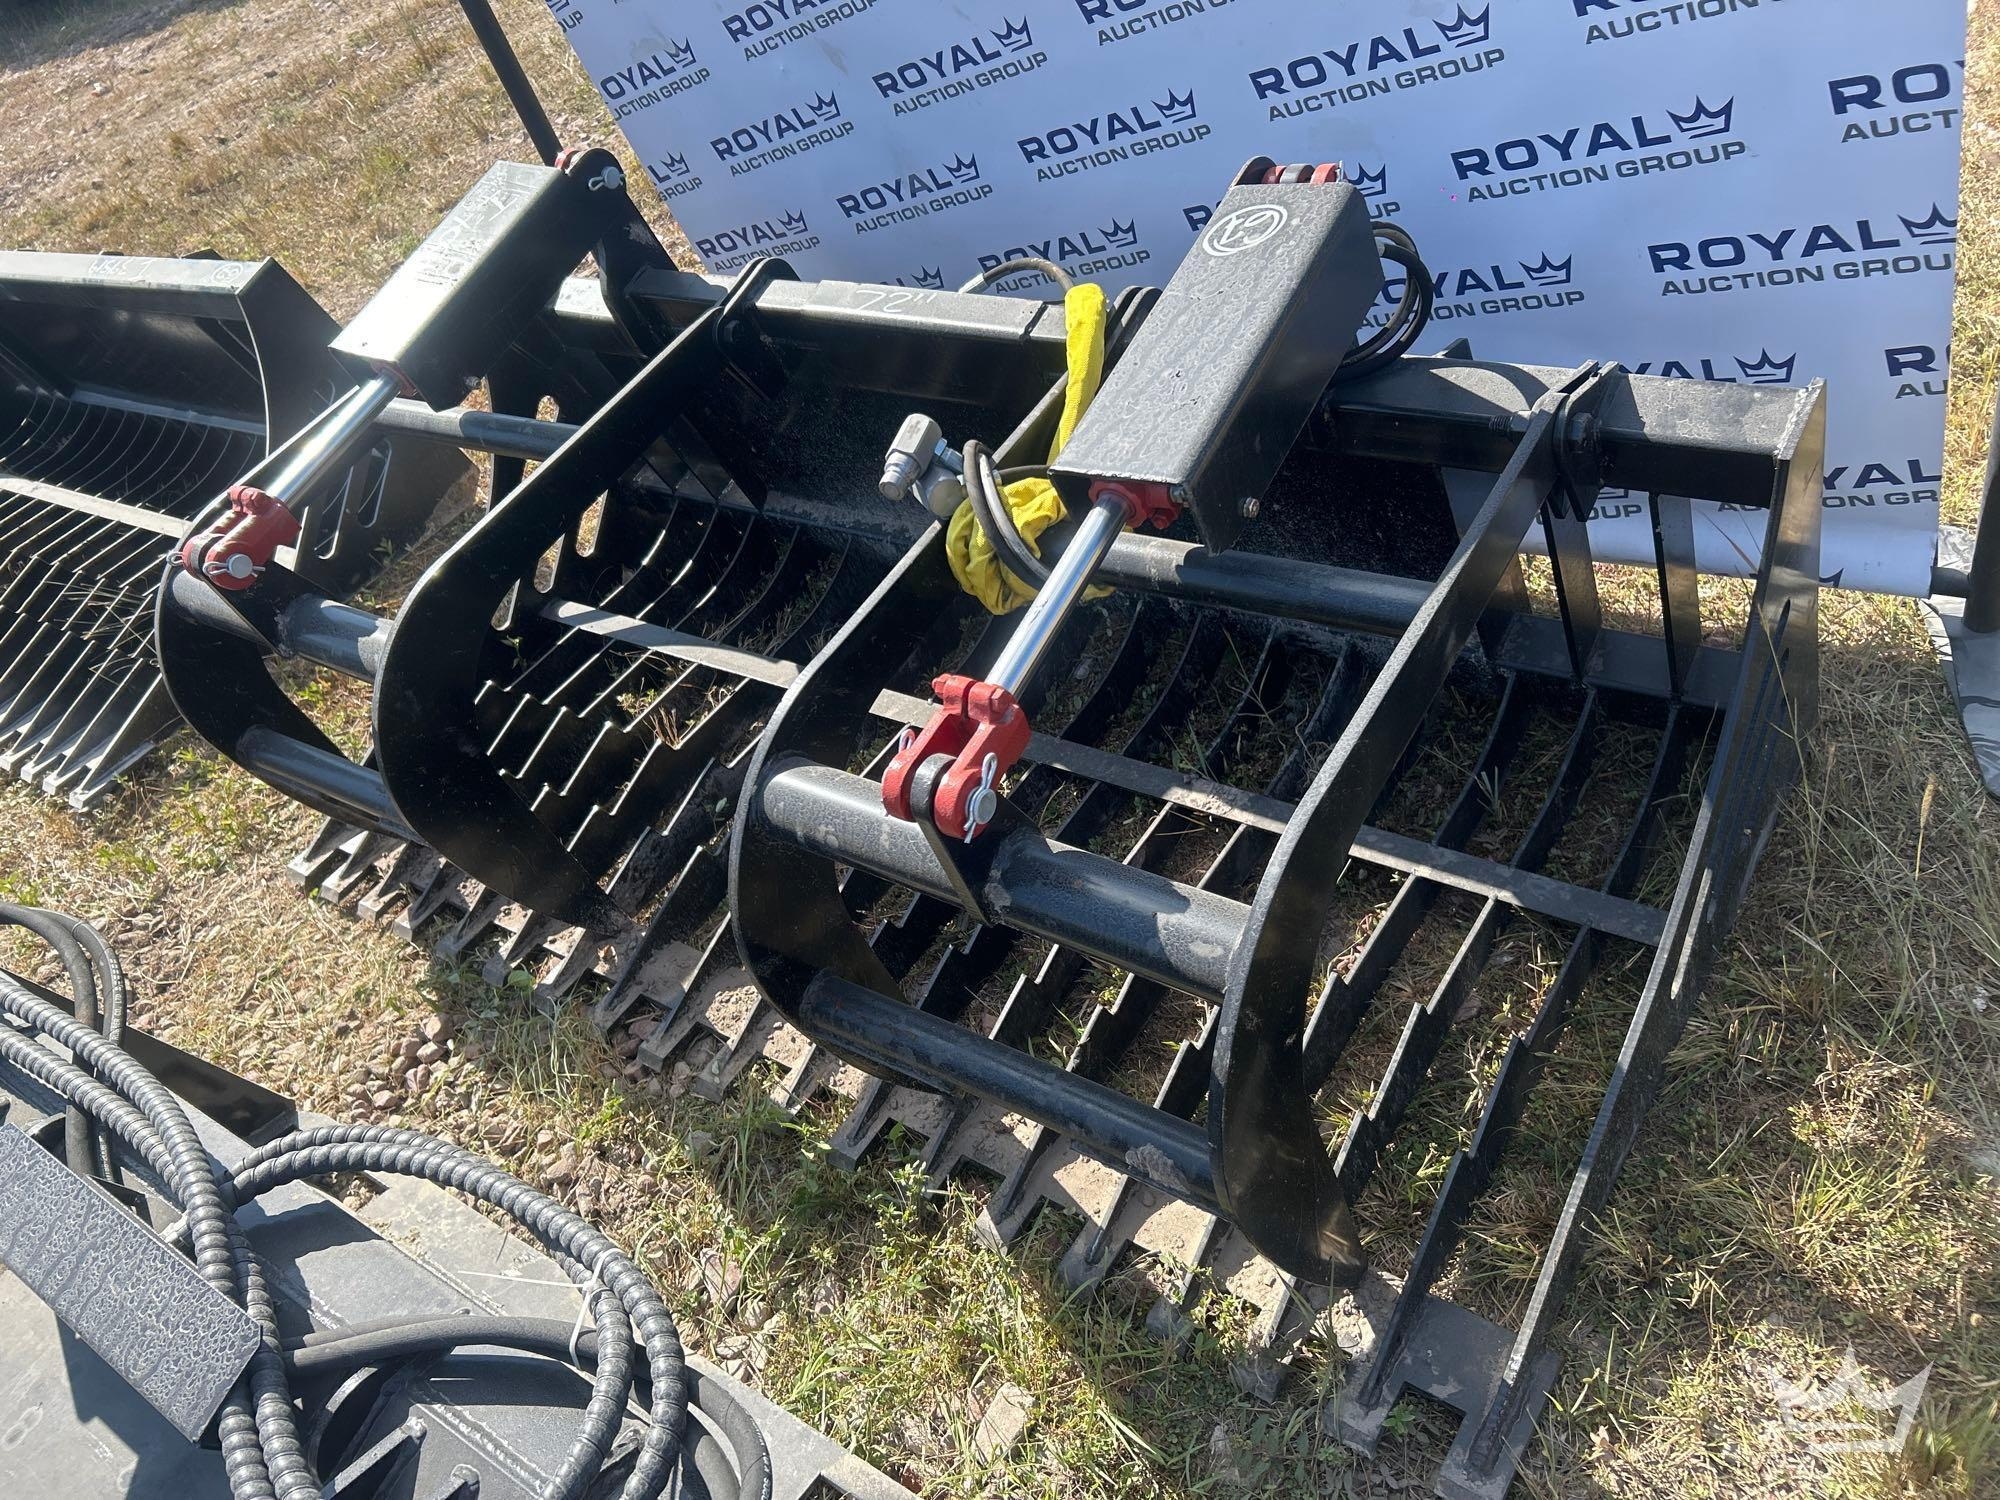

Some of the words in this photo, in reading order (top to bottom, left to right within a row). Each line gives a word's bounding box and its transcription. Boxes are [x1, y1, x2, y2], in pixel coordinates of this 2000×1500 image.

[722, 0, 831, 43] ROYA
[743, 20, 817, 62] AUCTION
[1098, 0, 1206, 46] AUCTION
[1586, 0, 1760, 44] AUCTION
[600, 54, 677, 100] OYAL
[872, 37, 1003, 98] ROYAL
[893, 78, 975, 117] AUCTION
[975, 51, 1048, 88] GROUP
[1249, 27, 1442, 100] ROYAL
[1269, 77, 1391, 122] AUCTION
[1394, 48, 1505, 90] GROUP
[614, 90, 662, 121] UCTION
[659, 68, 711, 99] GROUP
[710, 107, 817, 162] ROYAL
[729, 142, 797, 177] AUCTION
[799, 121, 855, 152] GROUP
[1017, 106, 1162, 164] ROYAL
[1450, 115, 1673, 181] ROYAL
[1841, 108, 1959, 143] AUCT
[1037, 146, 1129, 183] AUCTION
[1129, 124, 1211, 161] GROUP
[1467, 164, 1609, 203] AUCTION
[1615, 141, 1747, 178] GROUP
[835, 167, 954, 219] ROYAL
[855, 203, 930, 234] AUCTION
[929, 183, 993, 213] GROUP
[695, 221, 788, 258] ROYAL
[771, 236, 821, 256] GROUP
[1078, 249, 1151, 276] GROUP
[1648, 219, 1901, 273] ROYAL
[1661, 265, 1824, 296] AUCTION
[1833, 253, 1951, 280] GROU
[1481, 290, 1585, 314] GROUP
[1823, 459, 1942, 490] YAL
